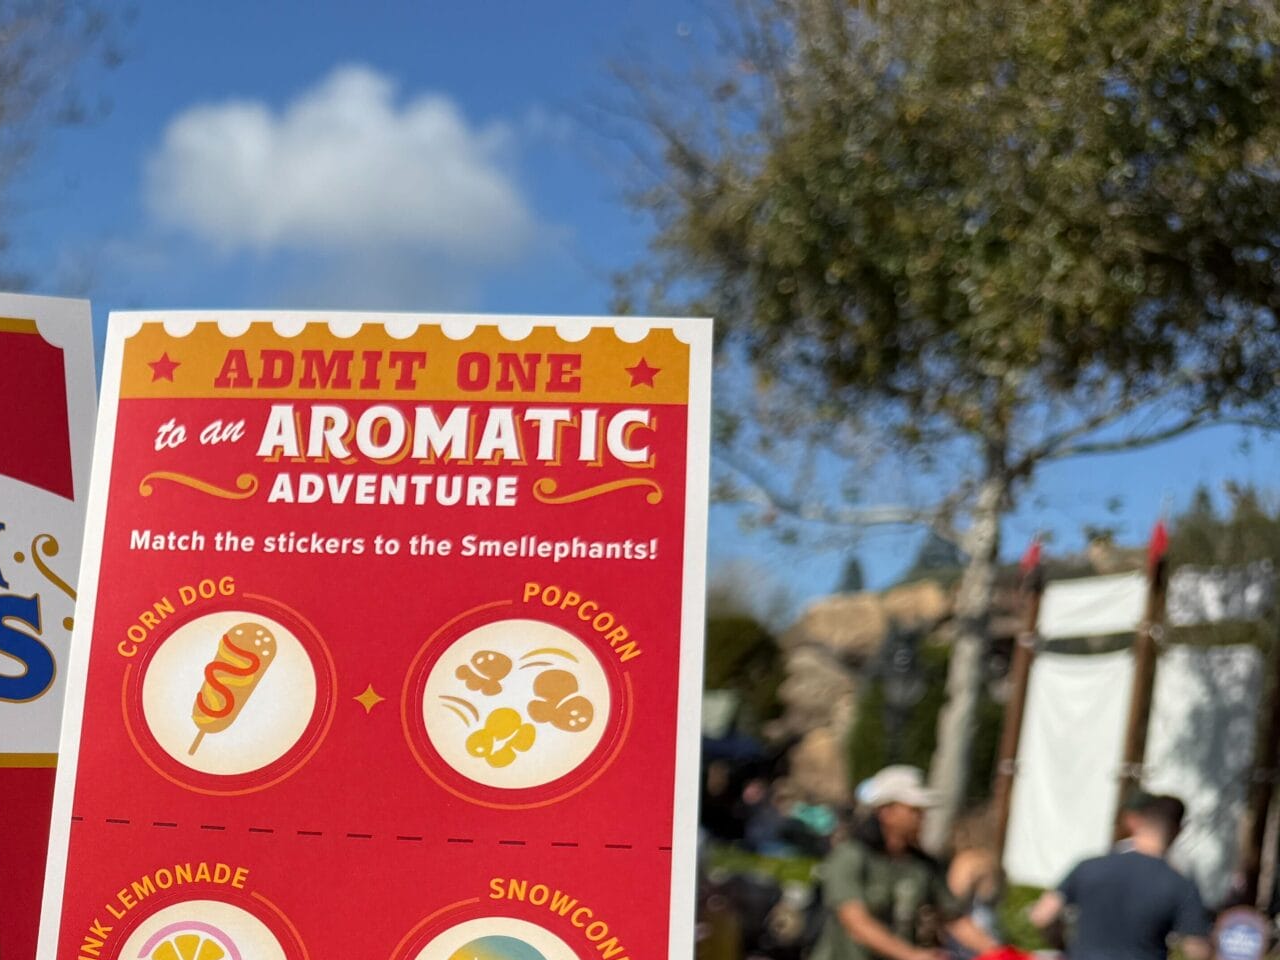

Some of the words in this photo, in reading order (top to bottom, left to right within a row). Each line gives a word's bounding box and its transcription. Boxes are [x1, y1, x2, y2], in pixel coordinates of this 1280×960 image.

[214, 349, 427, 391] ADMIT
[456, 352, 582, 393] ONE
[153, 416, 188, 452] to
[198, 417, 246, 445] an
[256, 403, 658, 469] AROMATIC
[267, 473, 519, 507] ADVENTURE
[129, 529, 205, 552] Match
[214, 531, 255, 553] the
[263, 532, 366, 555] stickers
[373, 535, 401, 556] to
[408, 534, 453, 557] the
[461, 534, 658, 564] Smellephants!
[117, 595, 177, 659] CORN
[177, 576, 236, 607] DOG
[523, 581, 642, 663] POPCORN
[104, 862, 250, 920] LEMONADE
